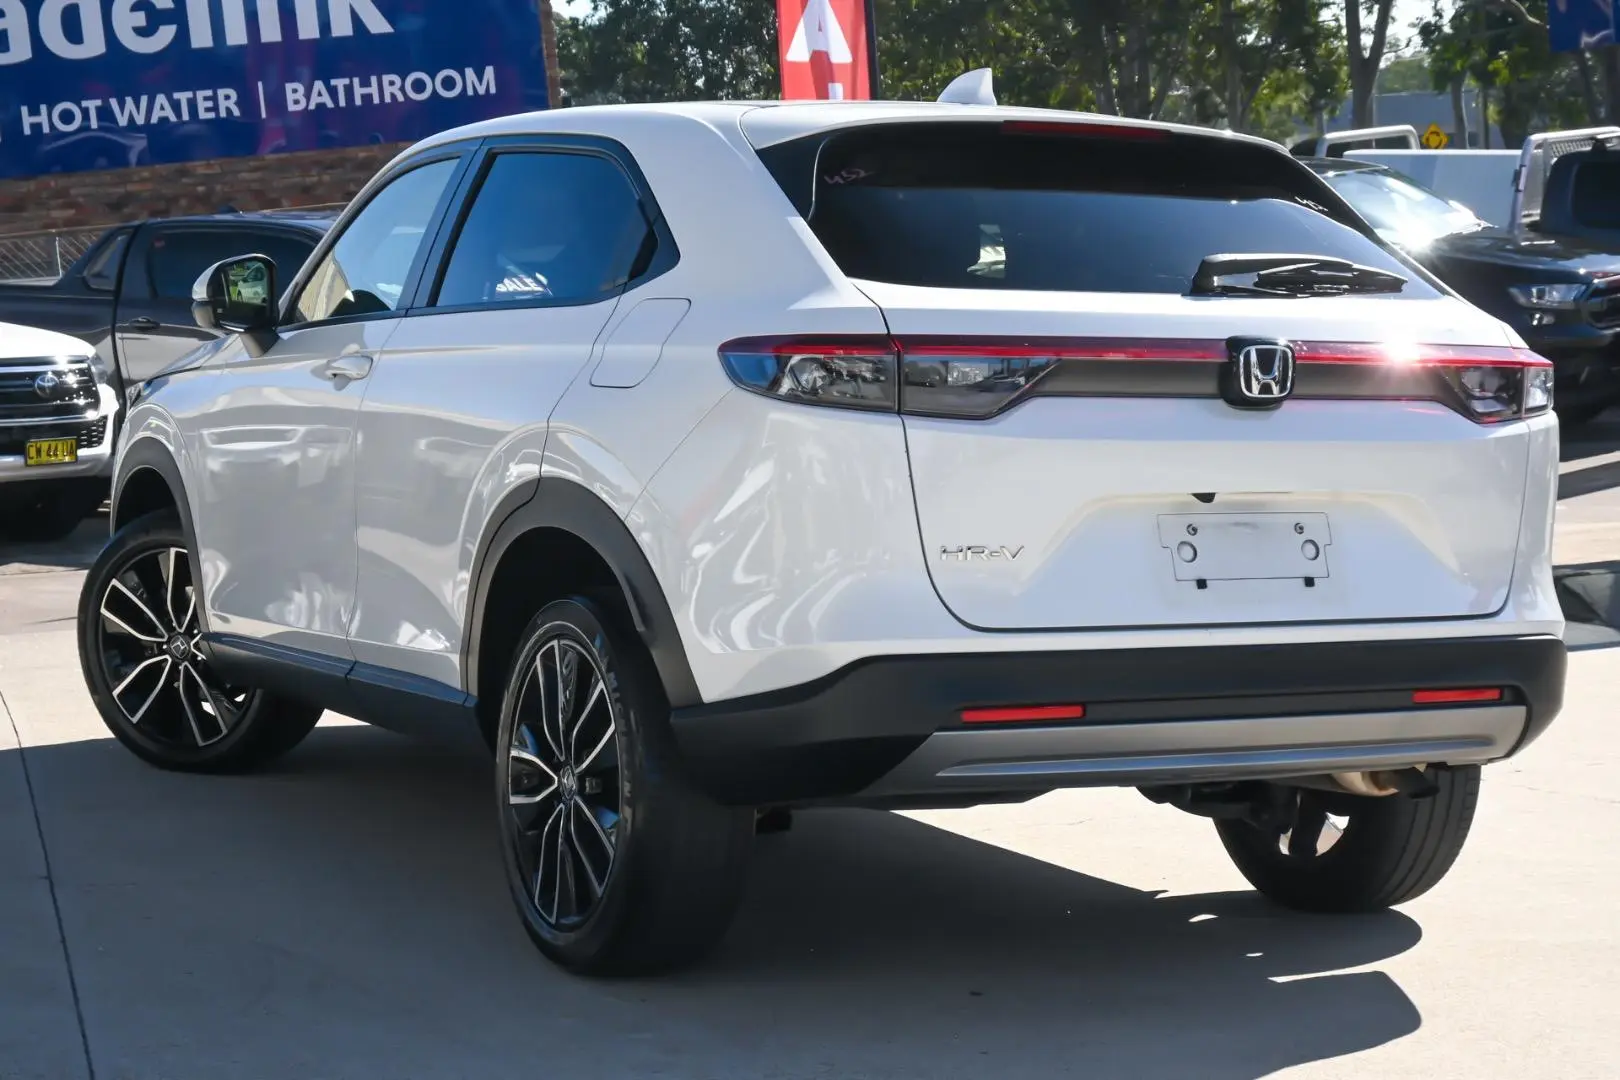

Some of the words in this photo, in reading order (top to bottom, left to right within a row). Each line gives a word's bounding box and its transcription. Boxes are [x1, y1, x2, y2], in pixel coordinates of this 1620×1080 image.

[21, 100, 101, 135] HOT
[109, 88, 241, 127] WATER
[285, 66, 496, 112] BATHROOM
[940, 545, 1025, 561] HR-V
